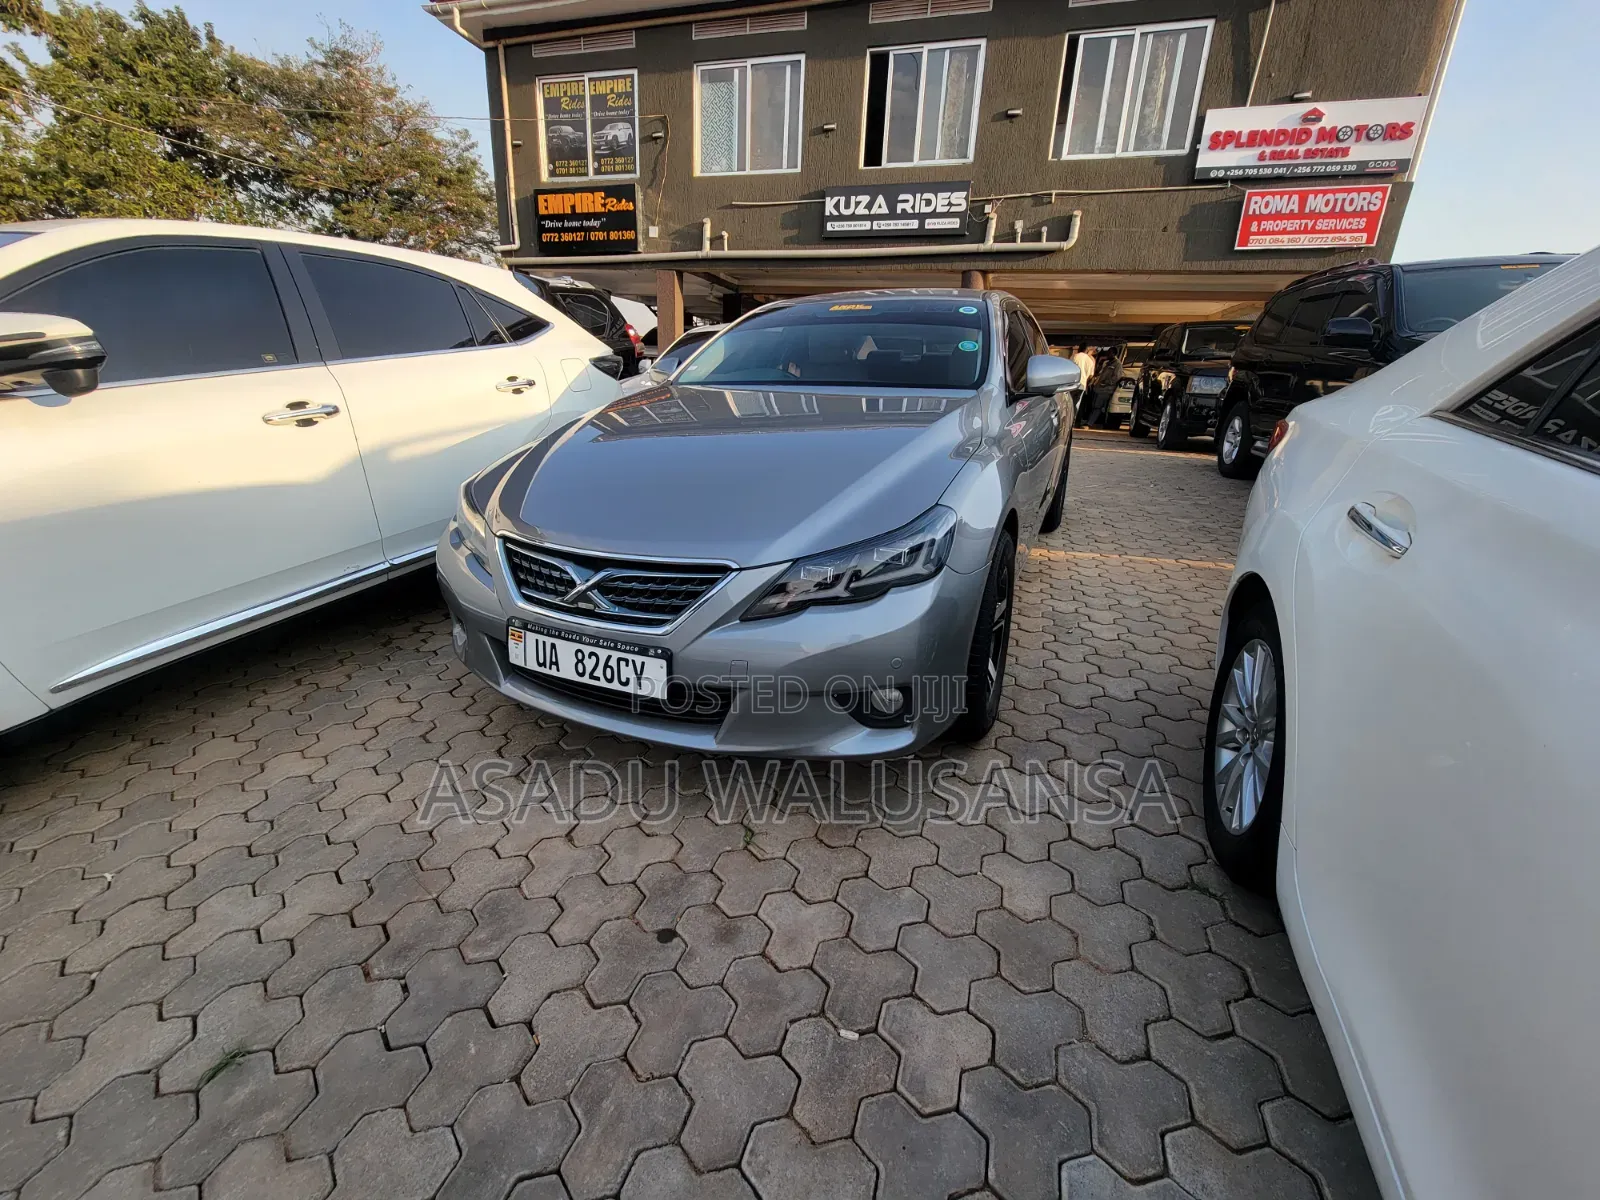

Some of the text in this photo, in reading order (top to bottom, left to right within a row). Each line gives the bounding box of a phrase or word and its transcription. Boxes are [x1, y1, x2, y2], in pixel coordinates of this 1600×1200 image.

[544, 81, 584, 98] EMPIRE
[590, 78, 632, 95] EMPIRE
[561, 96, 585, 110] Rides
[606, 94, 632, 108] Rides
[1208, 122, 1416, 150] SPLENDID MOTORS
[1258, 147, 1351, 161] & REAL ESTATE
[1226, 168, 1243, 176] +256
[1244, 168, 1258, 176] 705
[1273, 166, 1286, 174] 041
[1293, 166, 1310, 174] +256
[1326, 164, 1341, 172] 059
[1342, 164, 1356, 172] 330
[538, 192, 634, 215] EMPIRE Rides
[824, 192, 968, 216] KUZA RIDES
[1248, 192, 1383, 214] ROMA MOTORS
[564, 218, 582, 228] home
[1250, 218, 1366, 232] & PROPERTY SERVICES
[542, 233, 559, 242] 0772
[560, 232, 585, 242] 360127
[590, 231, 608, 241] 0701
[610, 230, 636, 240] 801360
[1249, 236, 1267, 245] 0701
[1268, 236, 1286, 244] 084
[1286, 236, 1302, 244] 160
[1308, 236, 1328, 244] 0772
[1330, 235, 1348, 244] 894
[527, 623, 639, 652] Making the Roads Your Safe Space
[535, 638, 646, 690] UA 826CY
